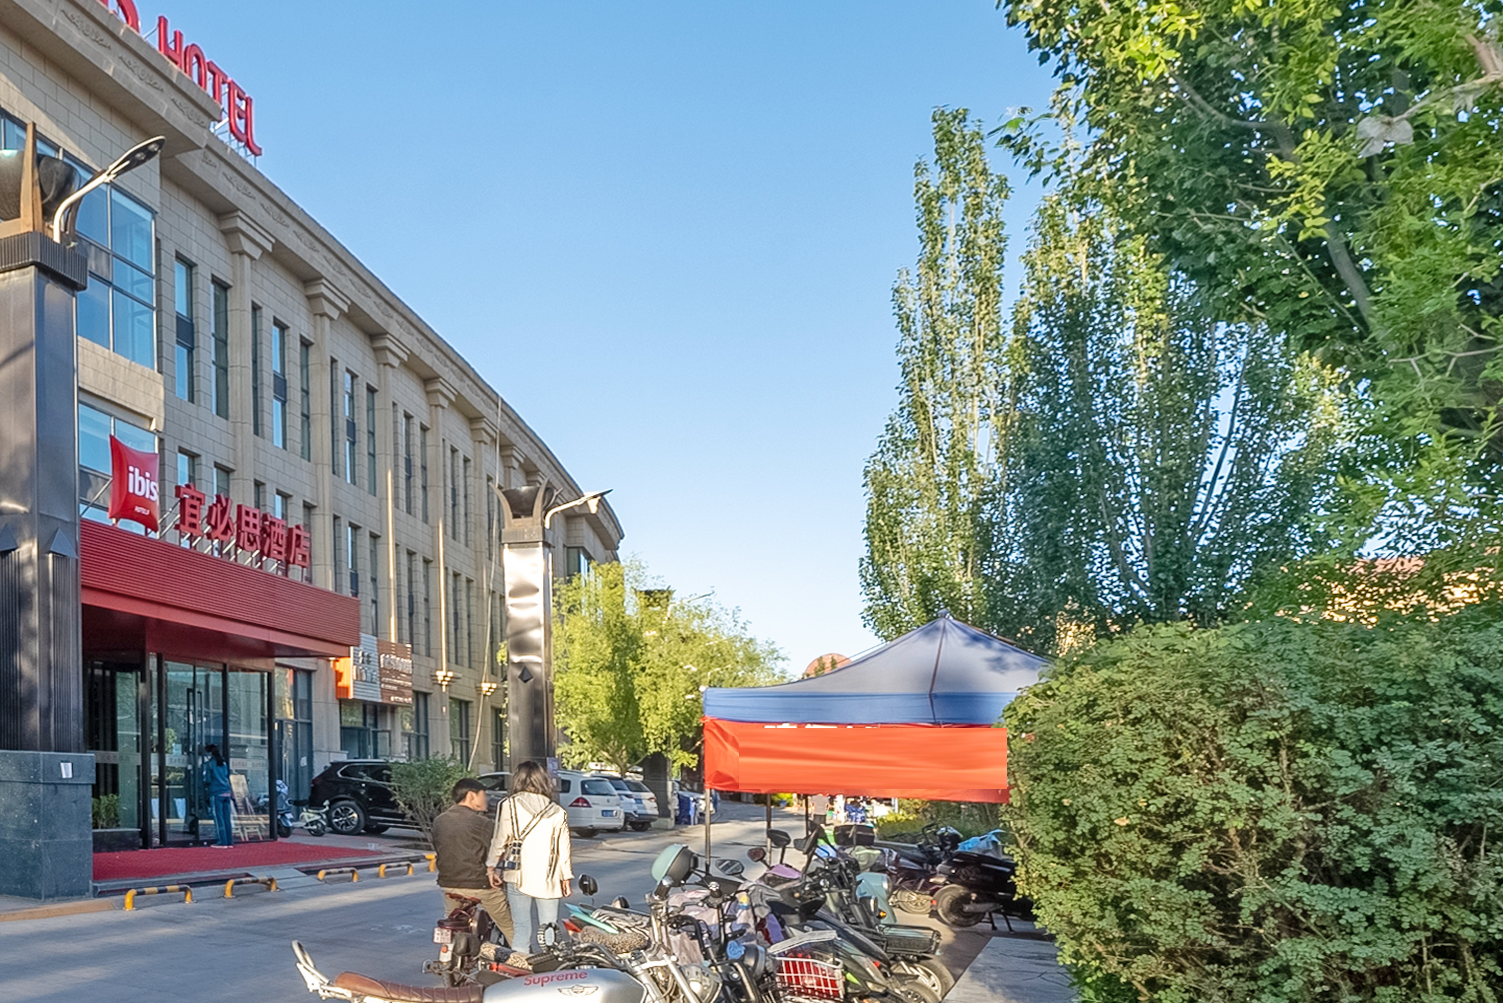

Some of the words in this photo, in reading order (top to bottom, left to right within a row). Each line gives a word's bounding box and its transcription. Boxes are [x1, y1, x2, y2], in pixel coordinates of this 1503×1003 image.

[158, 15, 262, 156] HOTEL
[127, 465, 159, 502] ibis
[174, 482, 311, 569] 宜必思酒店
[524, 970, 588, 987] Supreme
